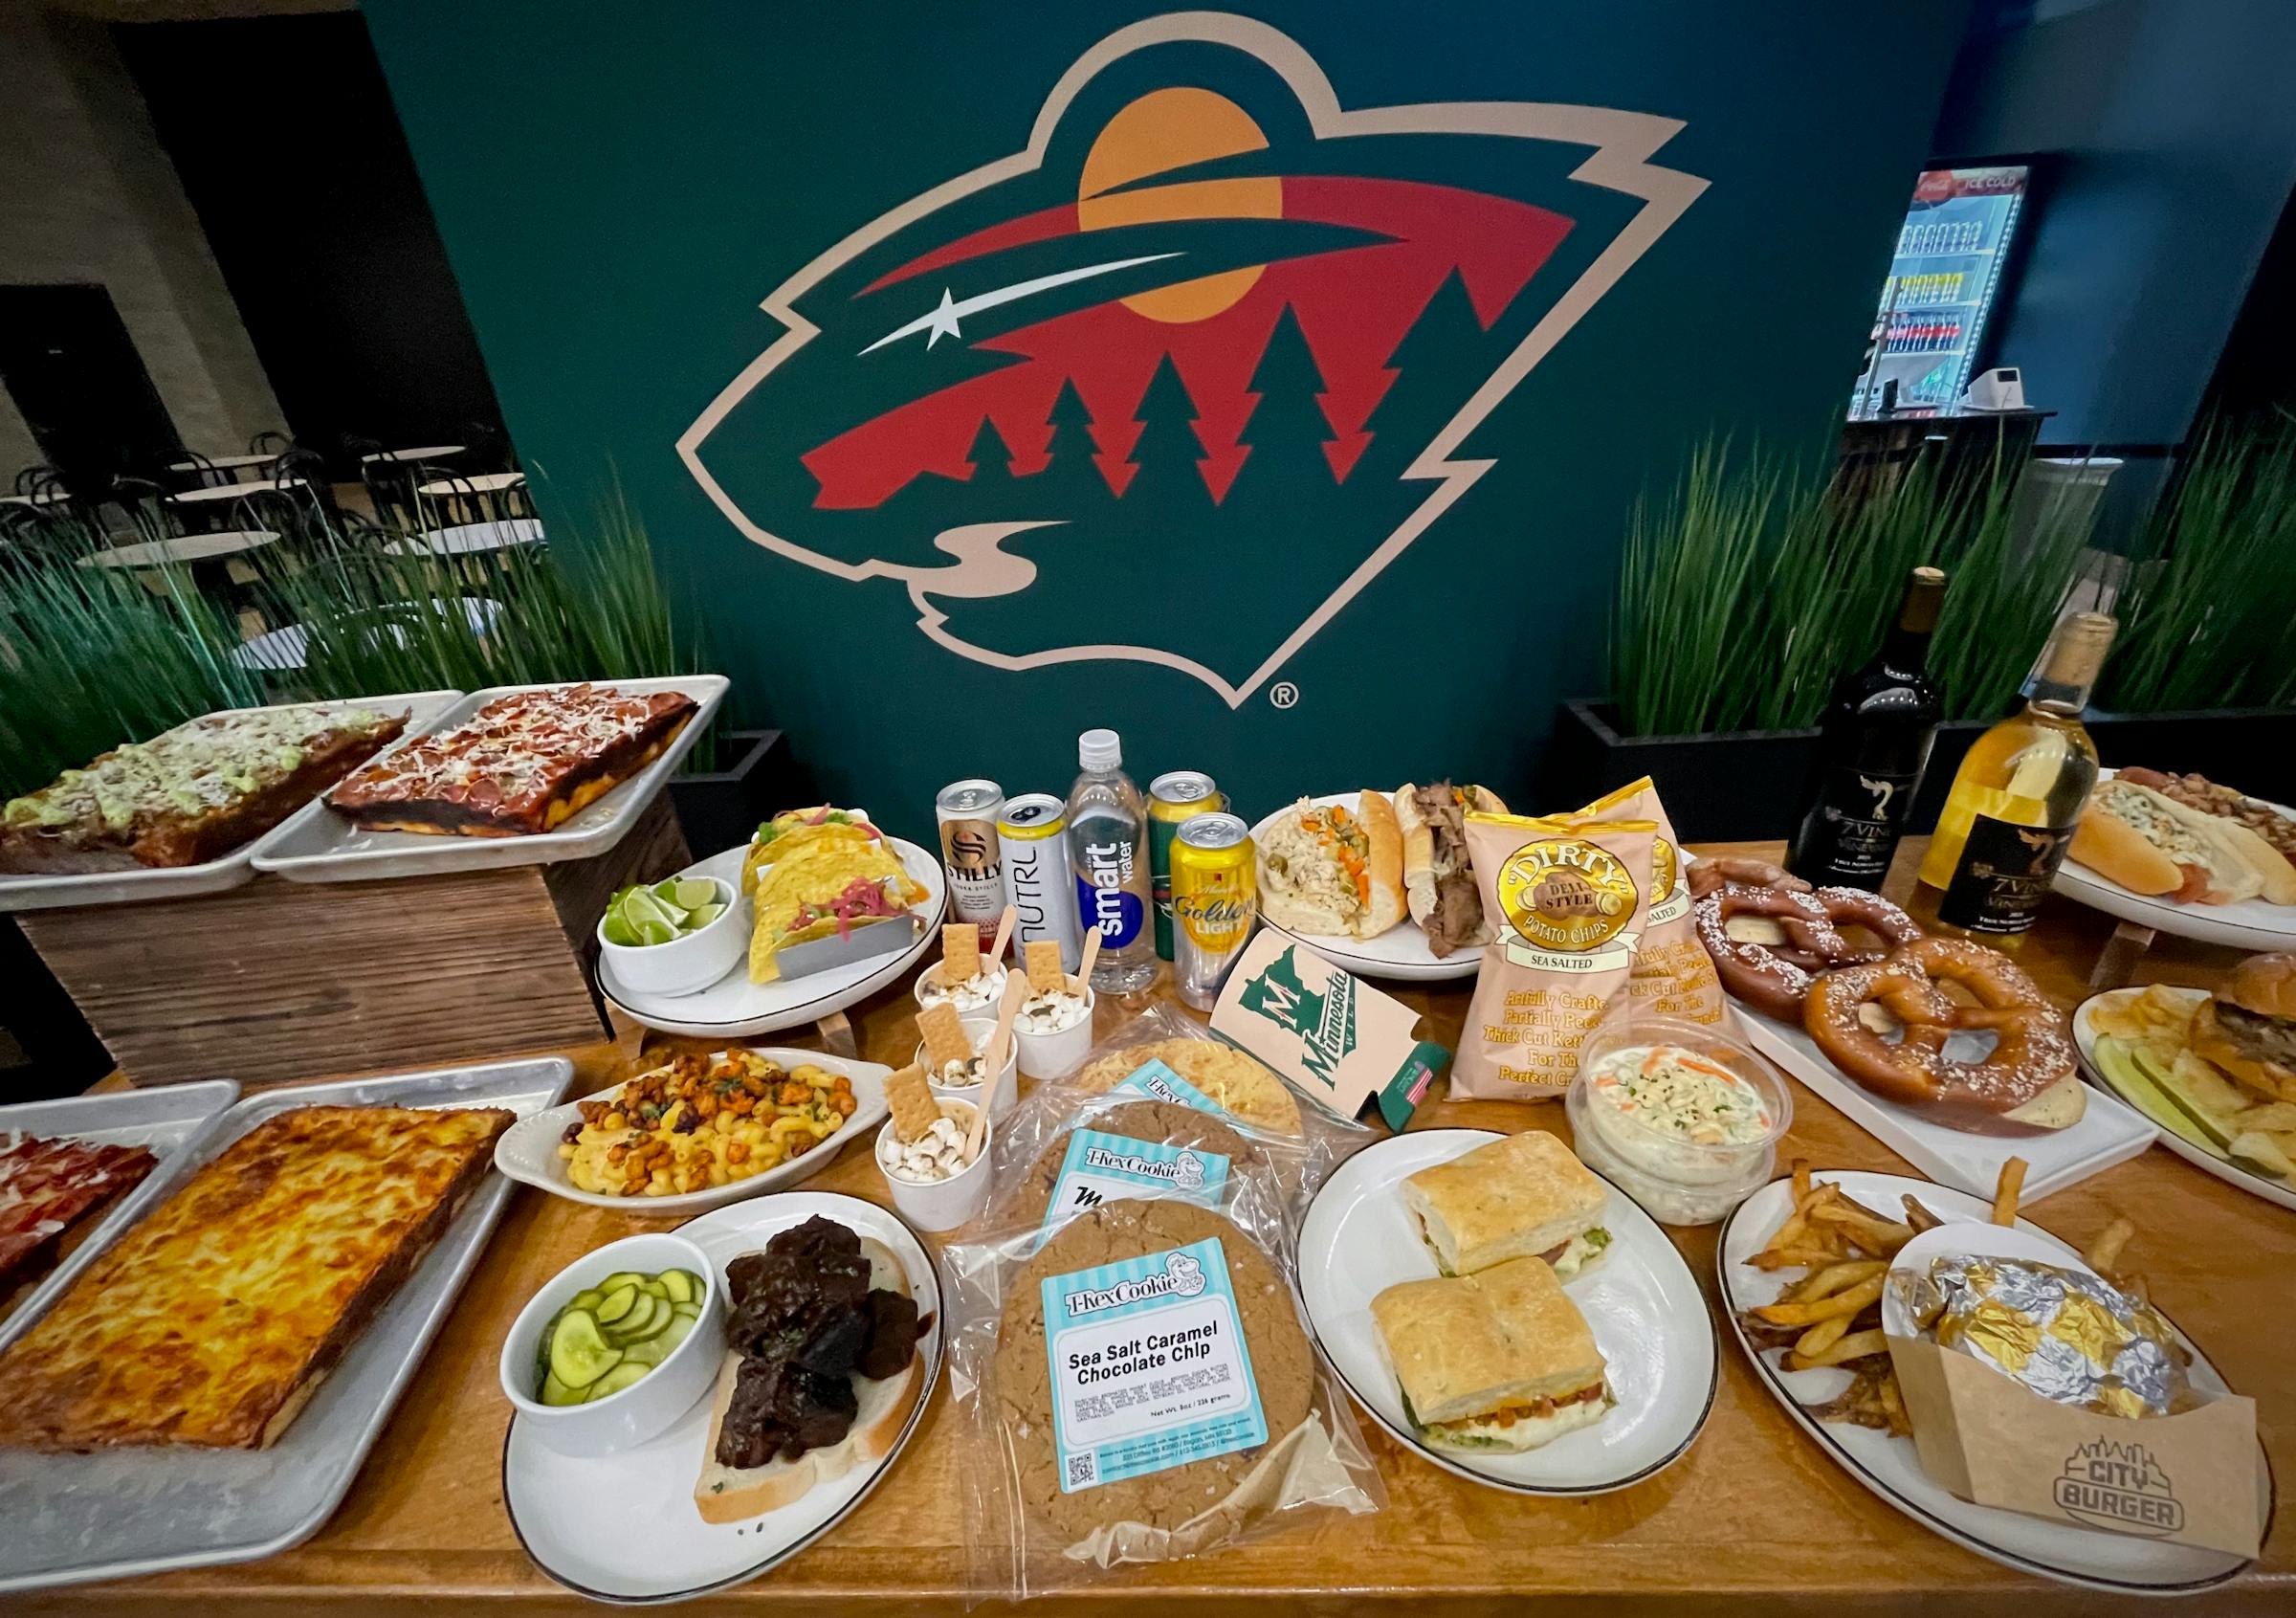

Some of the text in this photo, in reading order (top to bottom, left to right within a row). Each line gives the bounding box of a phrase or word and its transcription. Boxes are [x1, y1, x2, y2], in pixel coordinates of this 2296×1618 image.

[1964, 176, 2017, 188] ICE COLD
[1119, 841, 1134, 884] water
[1086, 843, 1123, 936] smart
[1546, 894, 1593, 909] STYLE
[1175, 896, 1254, 921] Golden
[1523, 915, 1609, 943] POTATO CHIPS
[1531, 955, 1593, 968] SEA SALTED
[1262, 973, 1301, 1030] M
[1505, 990, 1555, 1010] Artfully
[1655, 998, 1682, 1013] For
[1301, 969, 1347, 1092] Minnesota
[1503, 1009, 1560, 1031] Partially
[1483, 1025, 1519, 1043] Thick
[1522, 1029, 1549, 1045] Cut
[1528, 1048, 1578, 1068] For Th
[1499, 1065, 1552, 1084] Perfect
[1069, 1320, 1218, 1369] Sea Salt Caramel
[1077, 1353, 1165, 1385] Chocolate
[1171, 1341, 1210, 1362] Chip
[2088, 1460, 2148, 1490] CITY
[2063, 1483, 2175, 1525] BURGER
